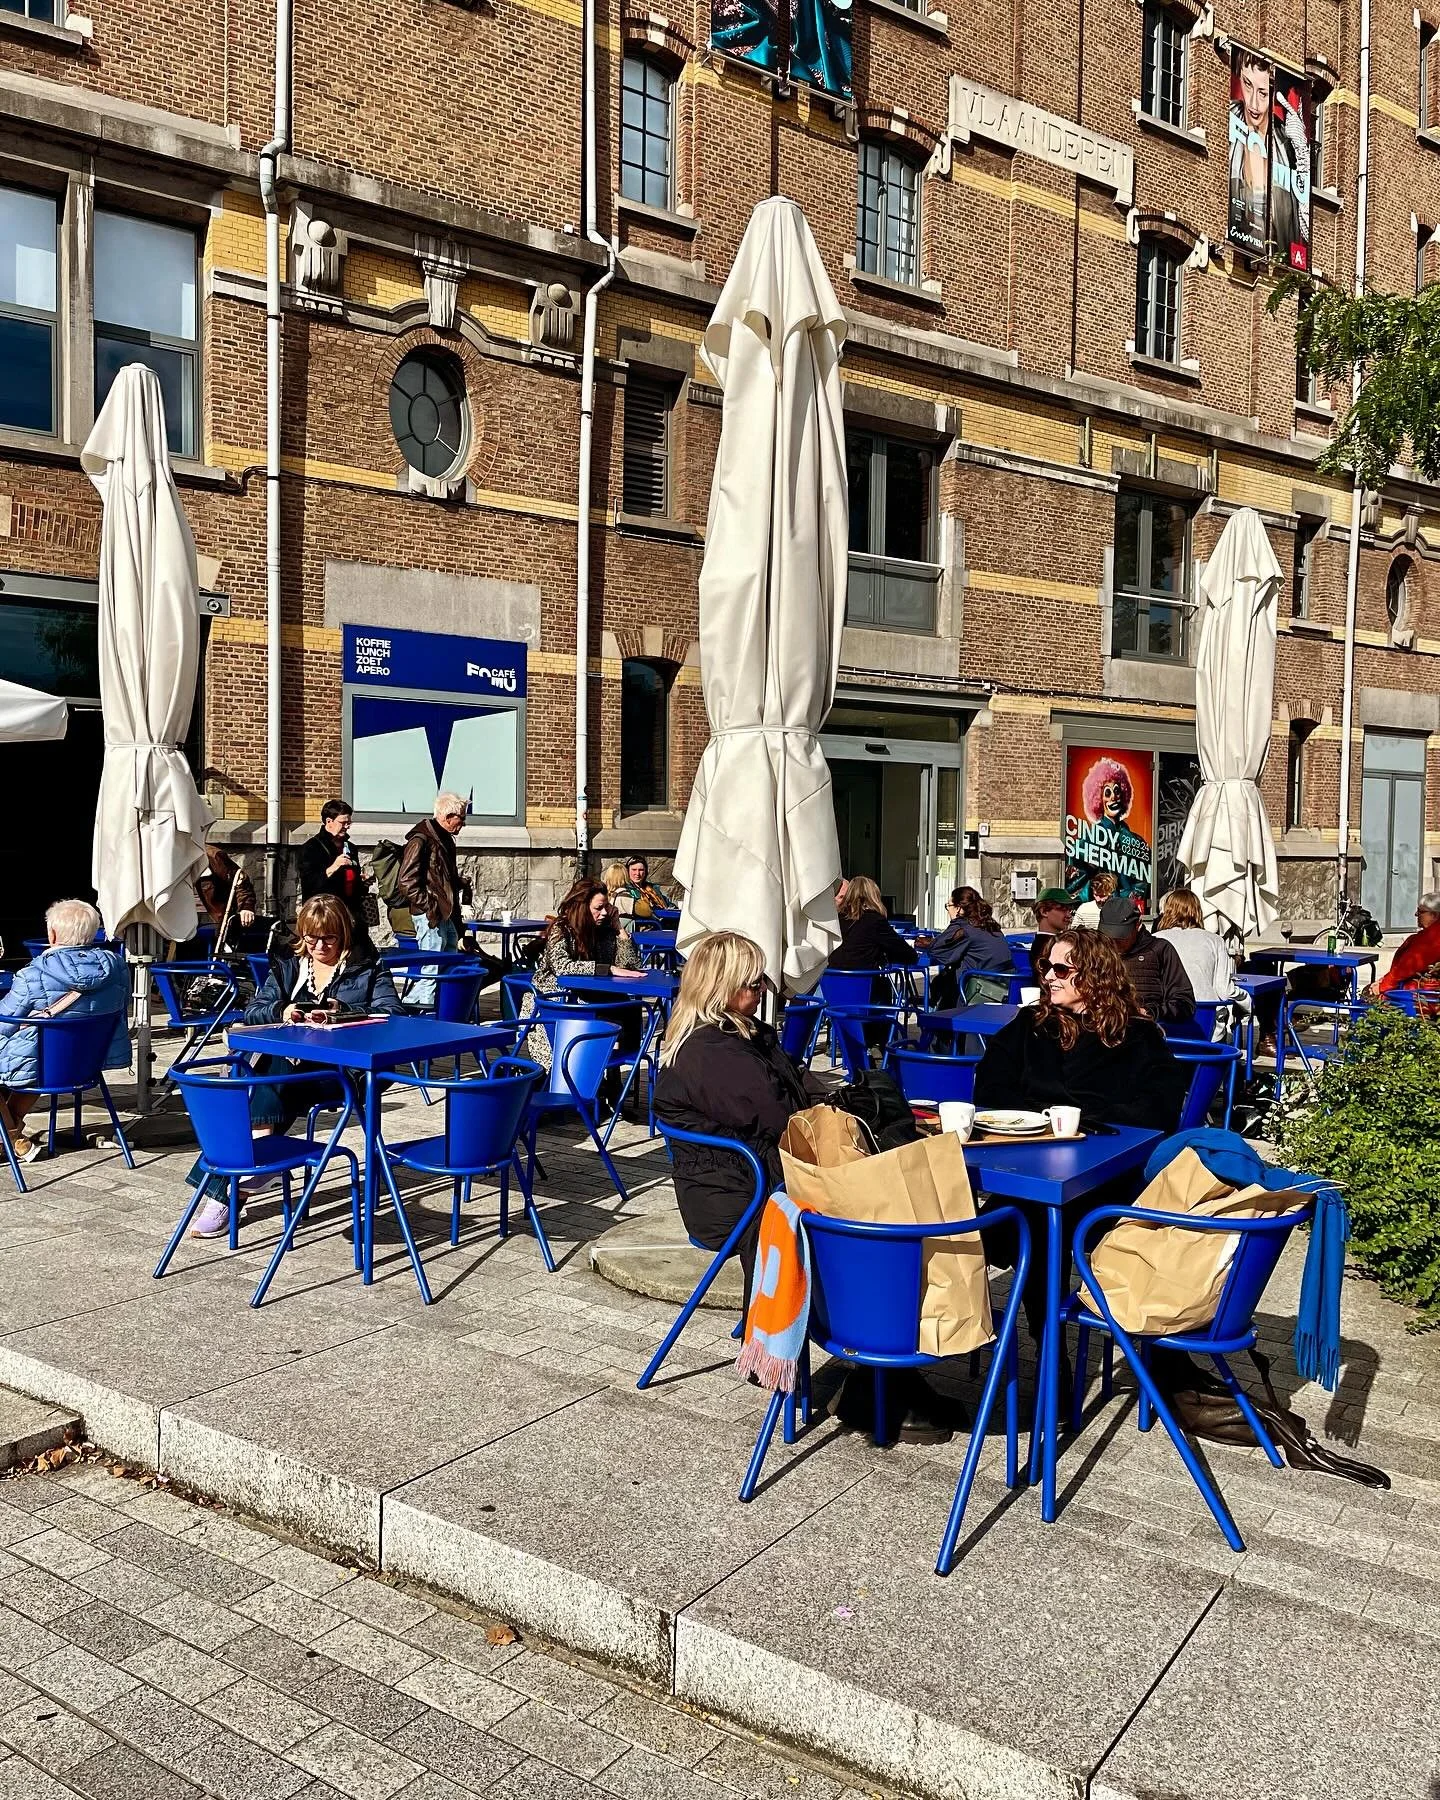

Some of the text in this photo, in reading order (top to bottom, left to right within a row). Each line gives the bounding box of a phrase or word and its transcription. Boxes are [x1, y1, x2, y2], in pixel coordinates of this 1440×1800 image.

[962, 87, 1127, 178] VLAANDEREN
[356, 637, 391, 649] KOFFIE
[356, 646, 391, 658] LUNCH
[356, 655, 382, 666] ZOET
[356, 664, 391, 676] APERO
[491, 668, 516, 679] CAFÉ
[1066, 815, 1120, 850] CINDY
[1065, 836, 1152, 884] SHERMAN
